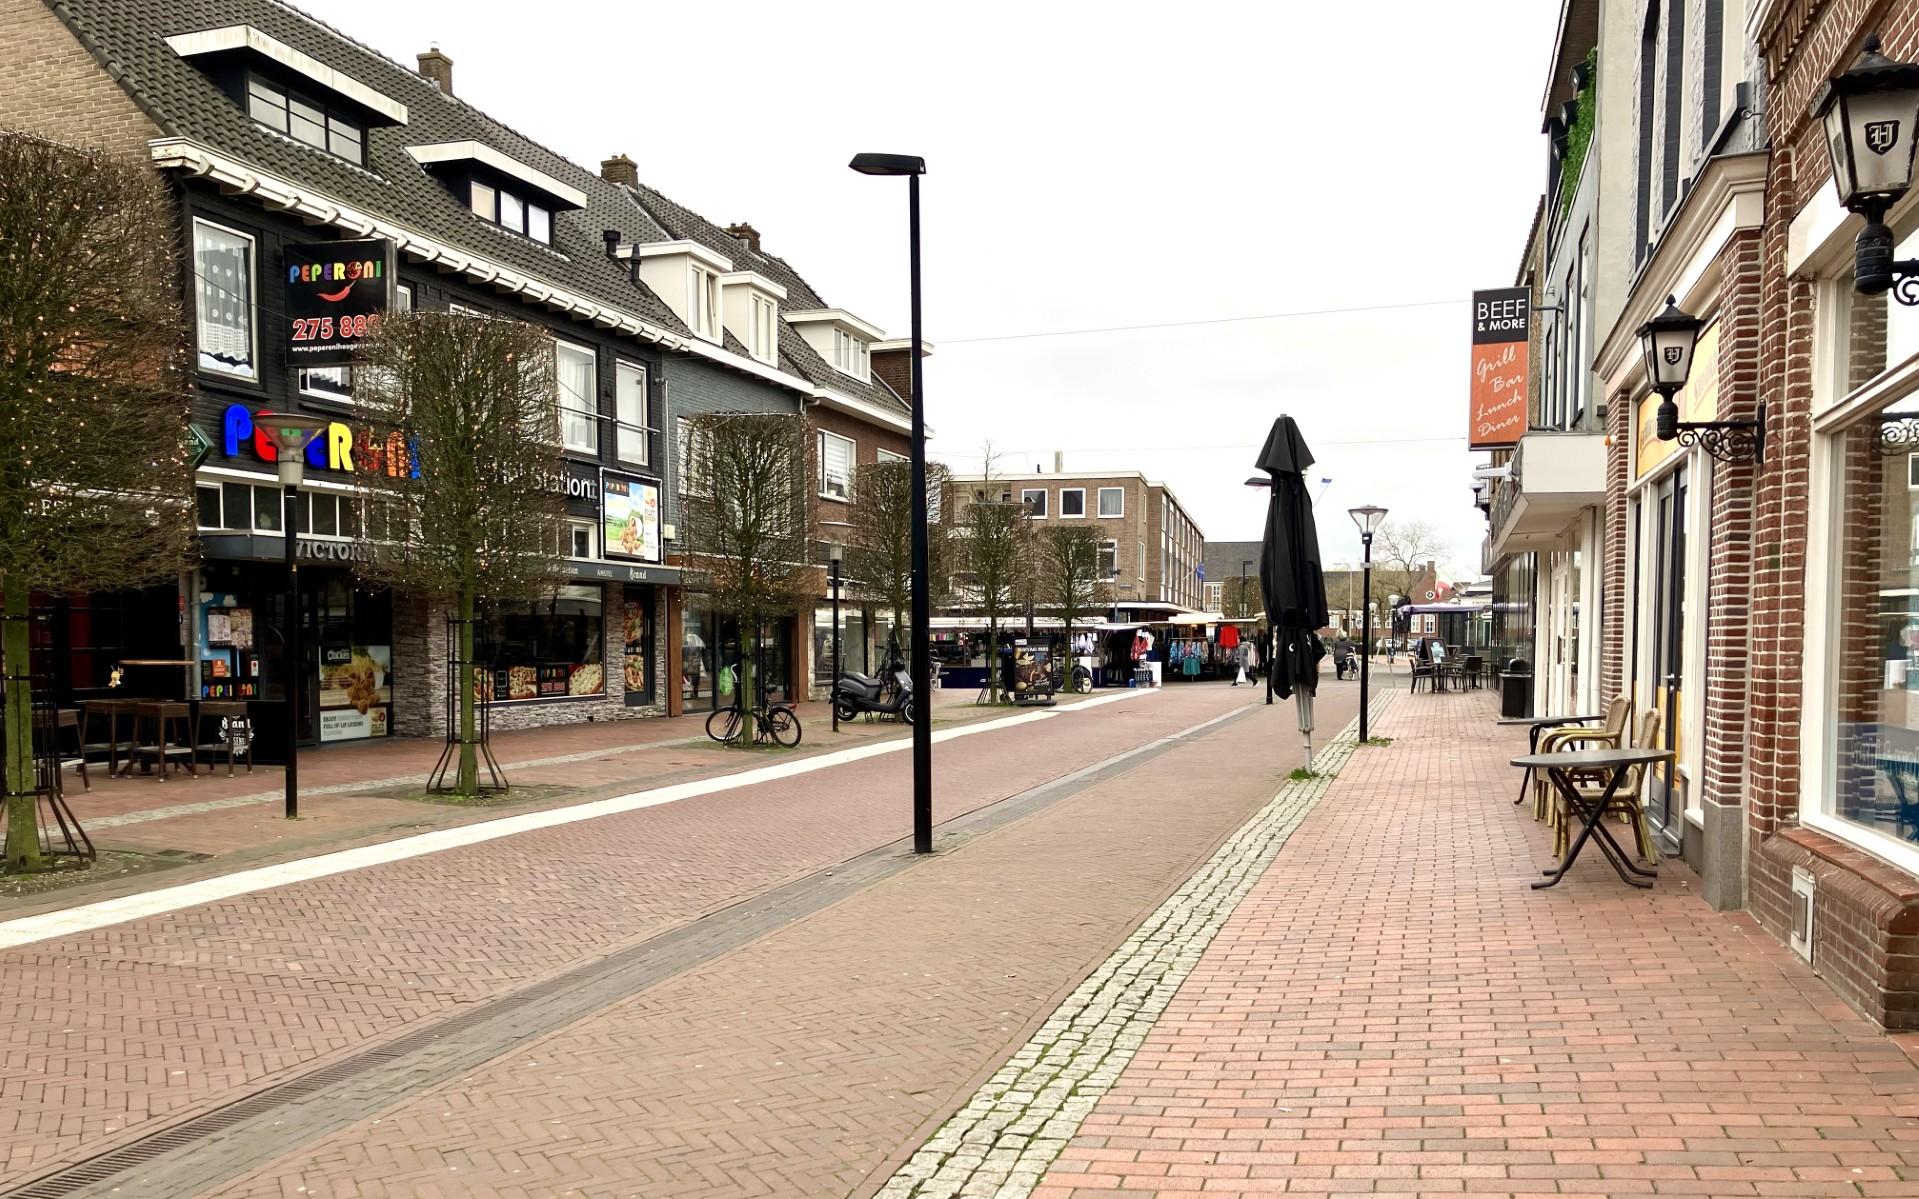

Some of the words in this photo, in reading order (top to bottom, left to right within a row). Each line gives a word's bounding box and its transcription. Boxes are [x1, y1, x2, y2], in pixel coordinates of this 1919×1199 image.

[289, 260, 382, 283] PEPERONI
[1477, 298, 1526, 320] BEEF
[291, 317, 334, 341] 275
[1477, 321, 1486, 331] &
[1489, 318, 1526, 331] MORE
[1476, 345, 1517, 383] Grill
[1489, 374, 1525, 393] Bar
[1475, 389, 1523, 422] Lunch
[1477, 415, 1521, 437] Diner
[221, 717, 251, 730] Ban
